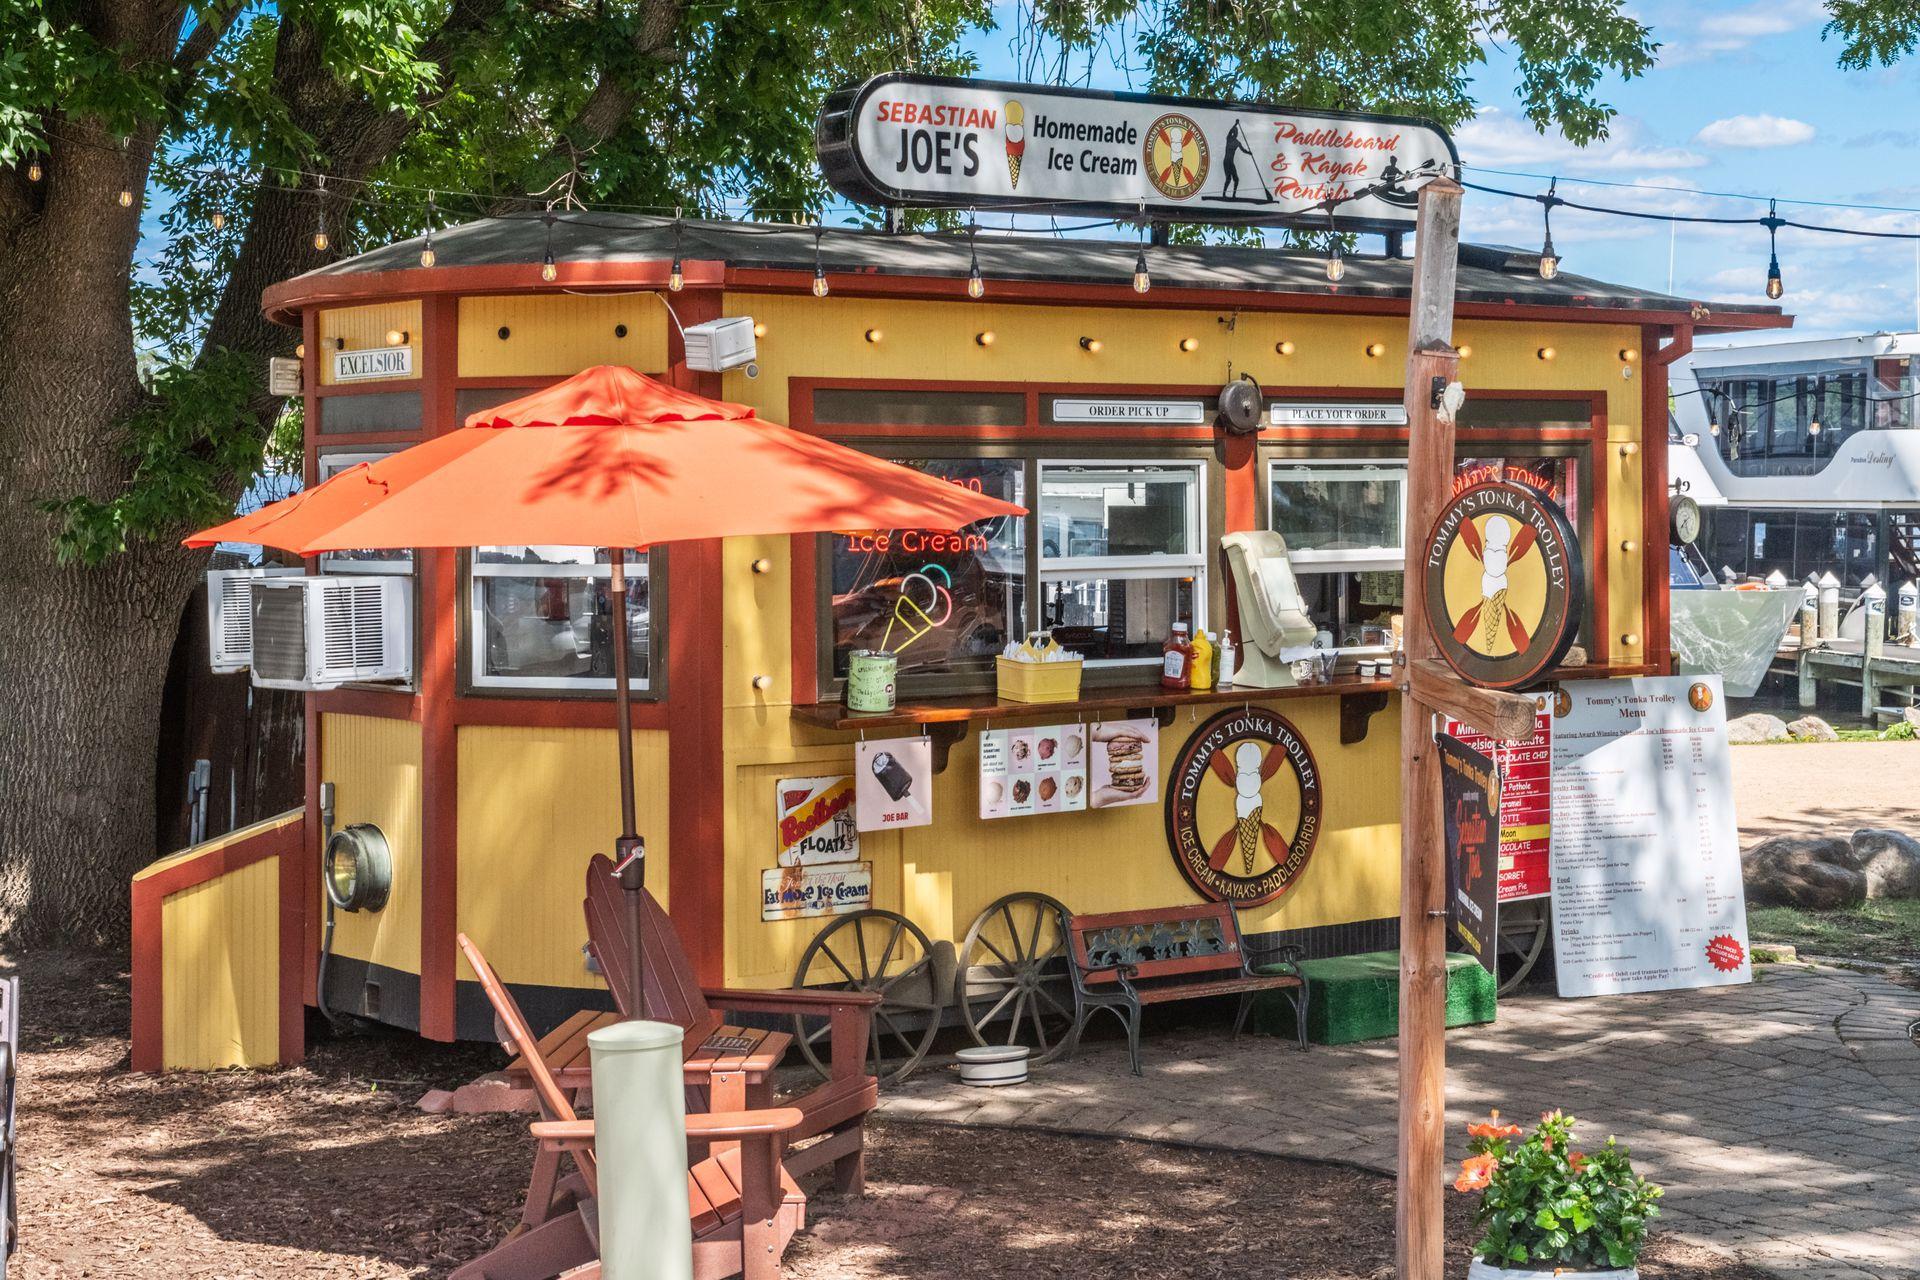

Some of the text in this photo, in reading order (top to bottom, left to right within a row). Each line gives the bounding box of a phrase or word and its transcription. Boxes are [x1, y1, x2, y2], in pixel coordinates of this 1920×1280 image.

[877, 101, 997, 129] SEBASTIAN
[1033, 115, 1138, 145] Homemade
[1273, 122, 1401, 152] Paddleboard
[896, 128, 980, 177] JOE'S
[1048, 148, 1138, 176] Ice Cream
[1270, 151, 1369, 183] & Kayak
[340, 352, 405, 376] EXCELSIOR
[1089, 406, 1169, 417] ORDER PICK UP
[1292, 409, 1387, 419] PLACE YOUR ORDER
[848, 531, 987, 552] Ice Cream
[1428, 490, 1564, 589] TOMMY'S TONKA TROLLEY
[1585, 693, 1676, 706] Tommy's Tonka Trolley
[1619, 708, 1646, 718] Menu
[1182, 718, 1315, 800] TOMMY'S TONKA TROLLEY
[1532, 750, 1548, 760] CHIP
[1508, 781, 1531, 791] Pothole
[1500, 798, 1521, 808] aramel
[883, 812, 909, 822] JOE BAR
[1501, 813, 1520, 823] OTTI
[1501, 830, 1517, 838] Moon
[800, 834, 846, 855] FLOATS
[1501, 841, 1531, 852] OCOLATE
[1180, 815, 1316, 898] ICE CREAM KAYAKS PADDLEBOARDS
[1499, 870, 1525, 881] SORBET
[764, 888, 779, 905] Eat
[816, 884, 834, 901] Ice
[835, 881, 869, 901] Cream
[1518, 882, 1527, 891] Pie
[1561, 928, 1579, 936] Drinks
